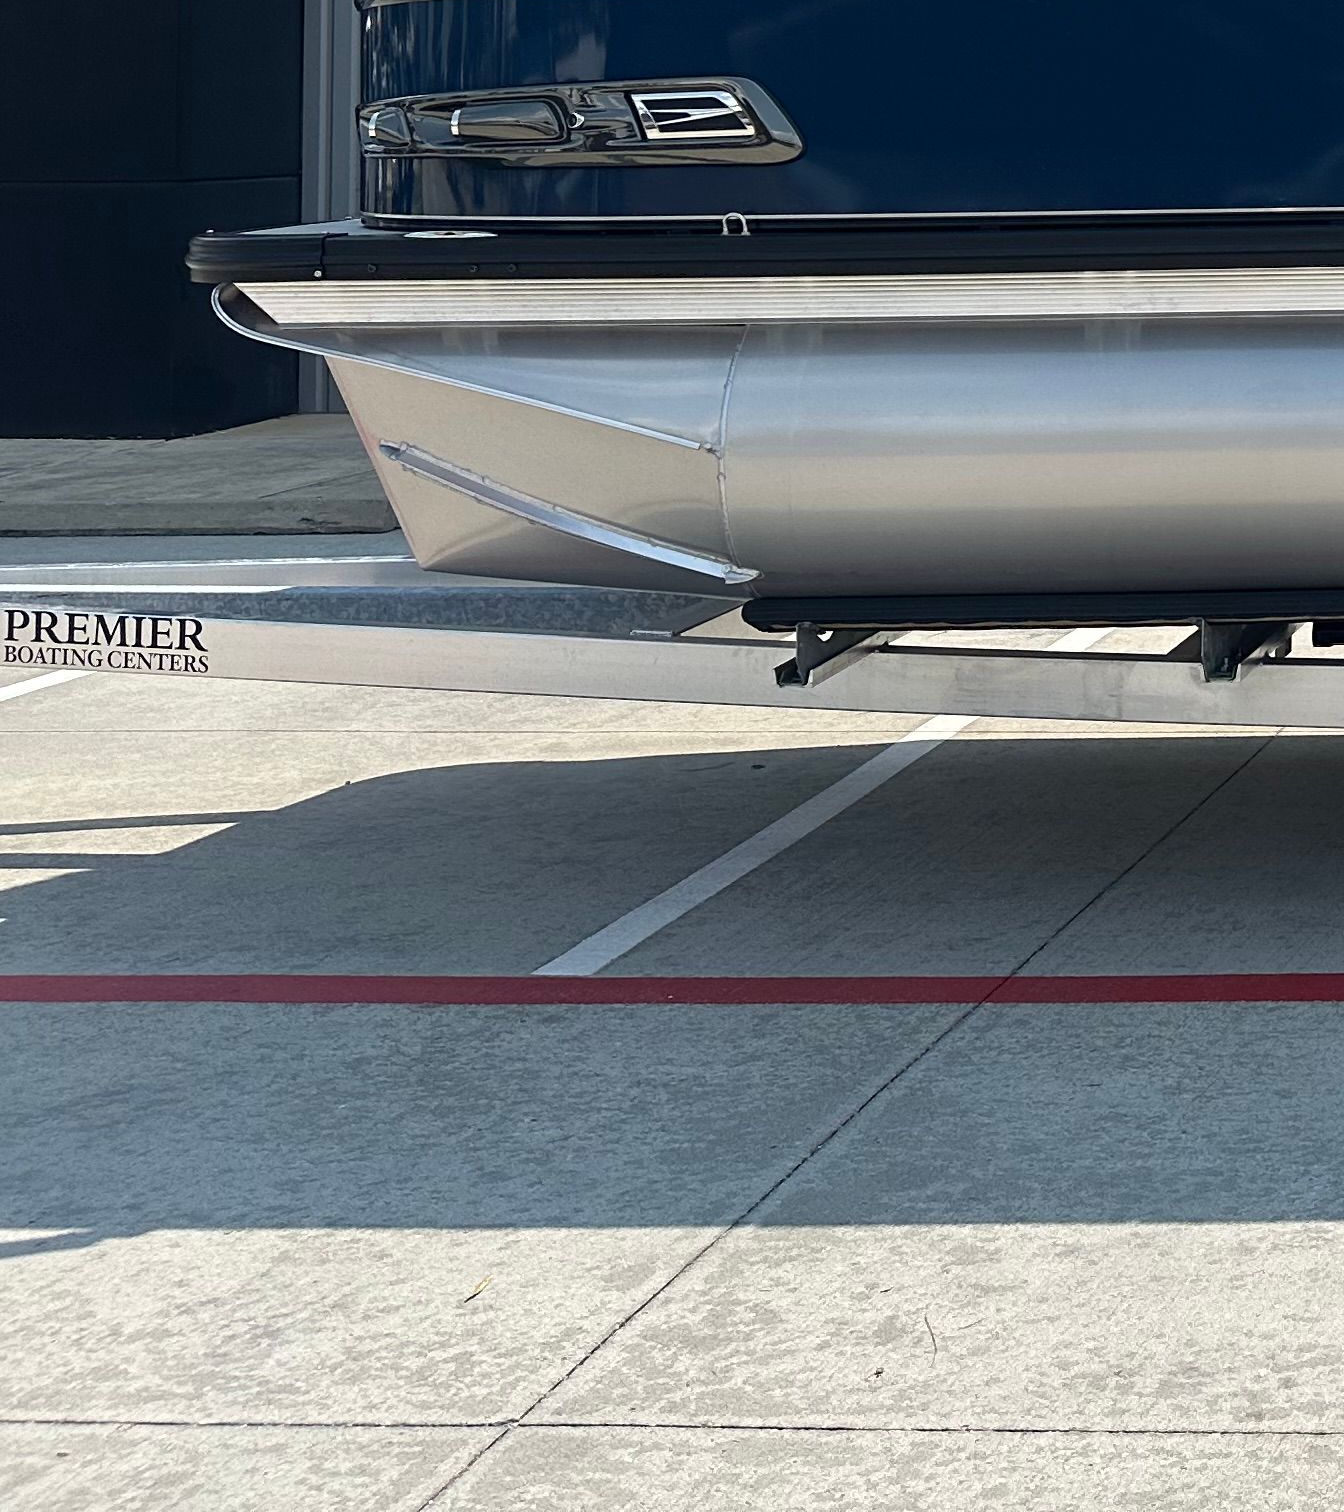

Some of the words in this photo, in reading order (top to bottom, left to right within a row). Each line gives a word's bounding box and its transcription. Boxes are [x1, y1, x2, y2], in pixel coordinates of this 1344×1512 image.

[4, 608, 209, 653] PREMIER
[4, 645, 103, 669] BOATING
[107, 650, 209, 675] CENTERS
